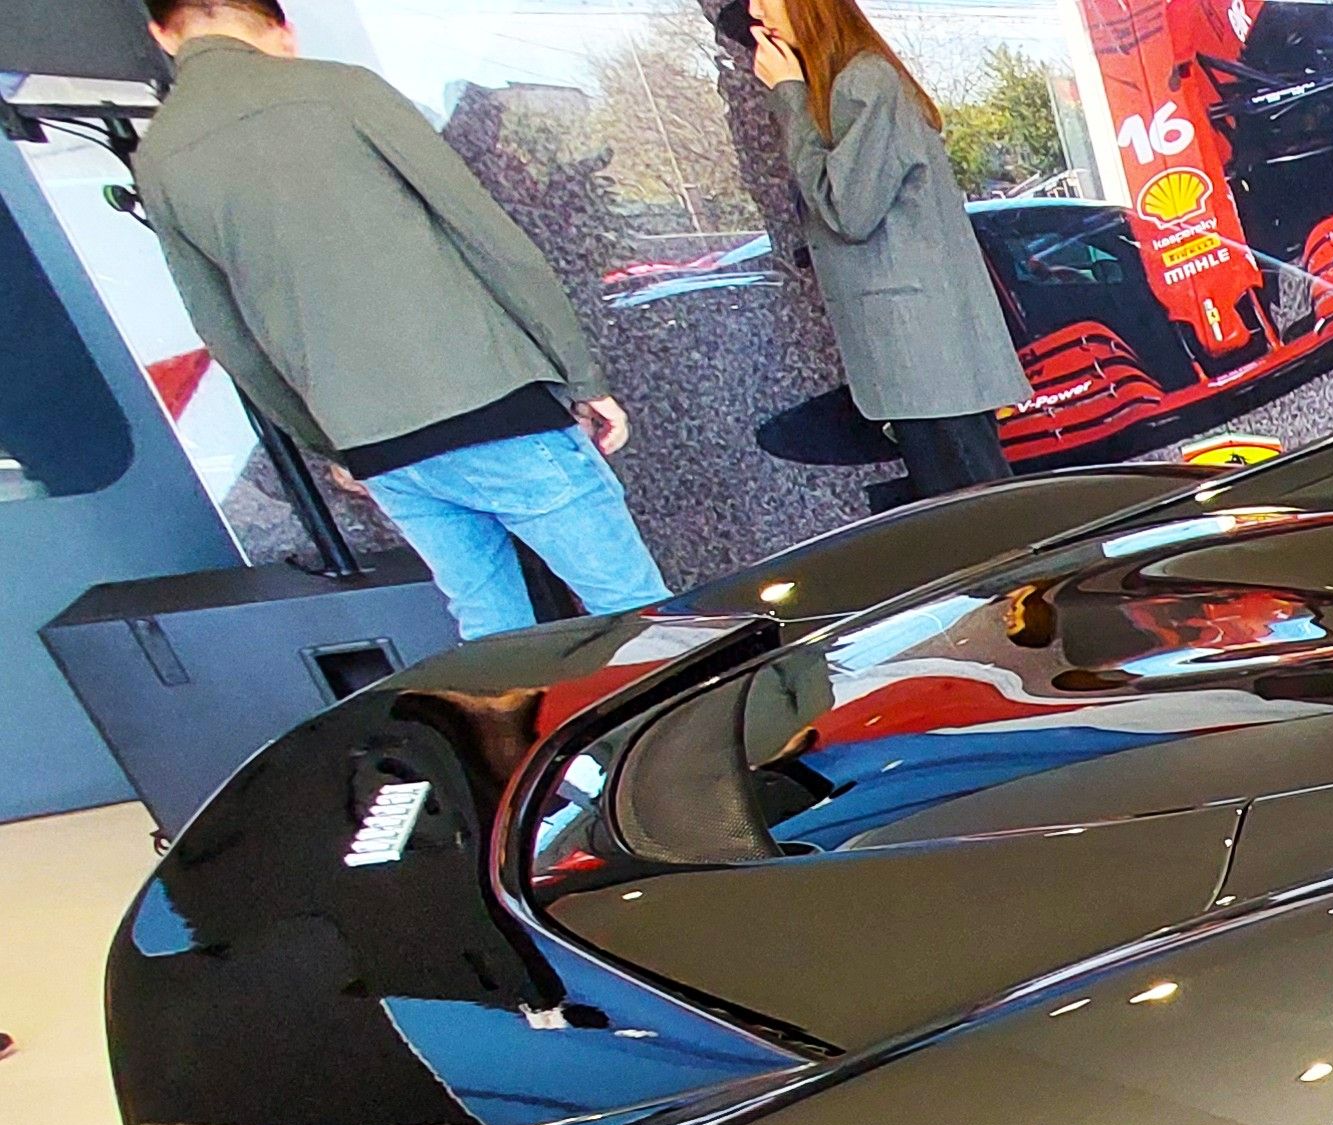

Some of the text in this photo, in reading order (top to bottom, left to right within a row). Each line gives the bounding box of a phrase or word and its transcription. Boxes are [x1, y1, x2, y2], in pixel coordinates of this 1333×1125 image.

[1117, 101, 1195, 165] 16
[1164, 248, 1231, 286] MAHLE
[1017, 380, 1093, 413] V-Power
